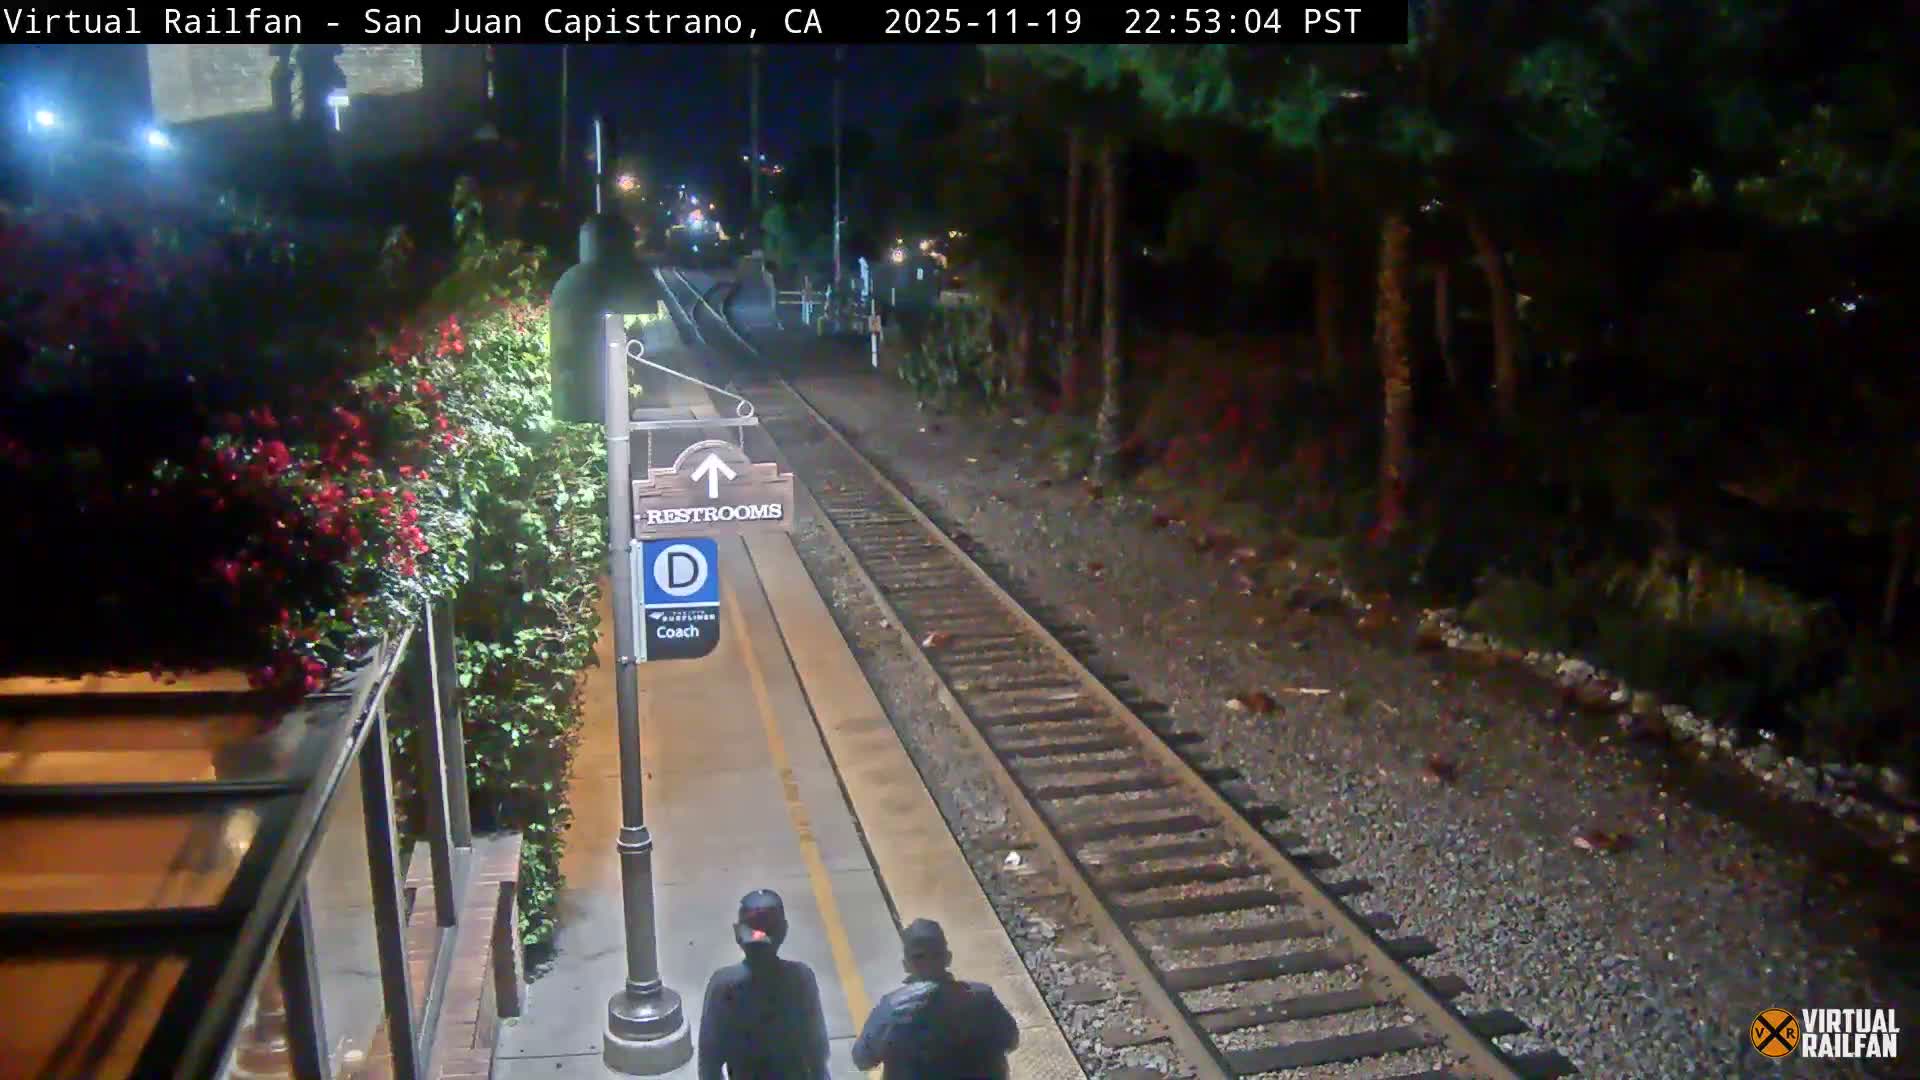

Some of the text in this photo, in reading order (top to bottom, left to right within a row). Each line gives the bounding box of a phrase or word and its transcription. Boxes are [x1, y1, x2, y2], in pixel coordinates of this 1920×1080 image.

[647, 503, 783, 525] RESTROOMS
[667, 551, 700, 589] D
[656, 624, 700, 639] Coach
